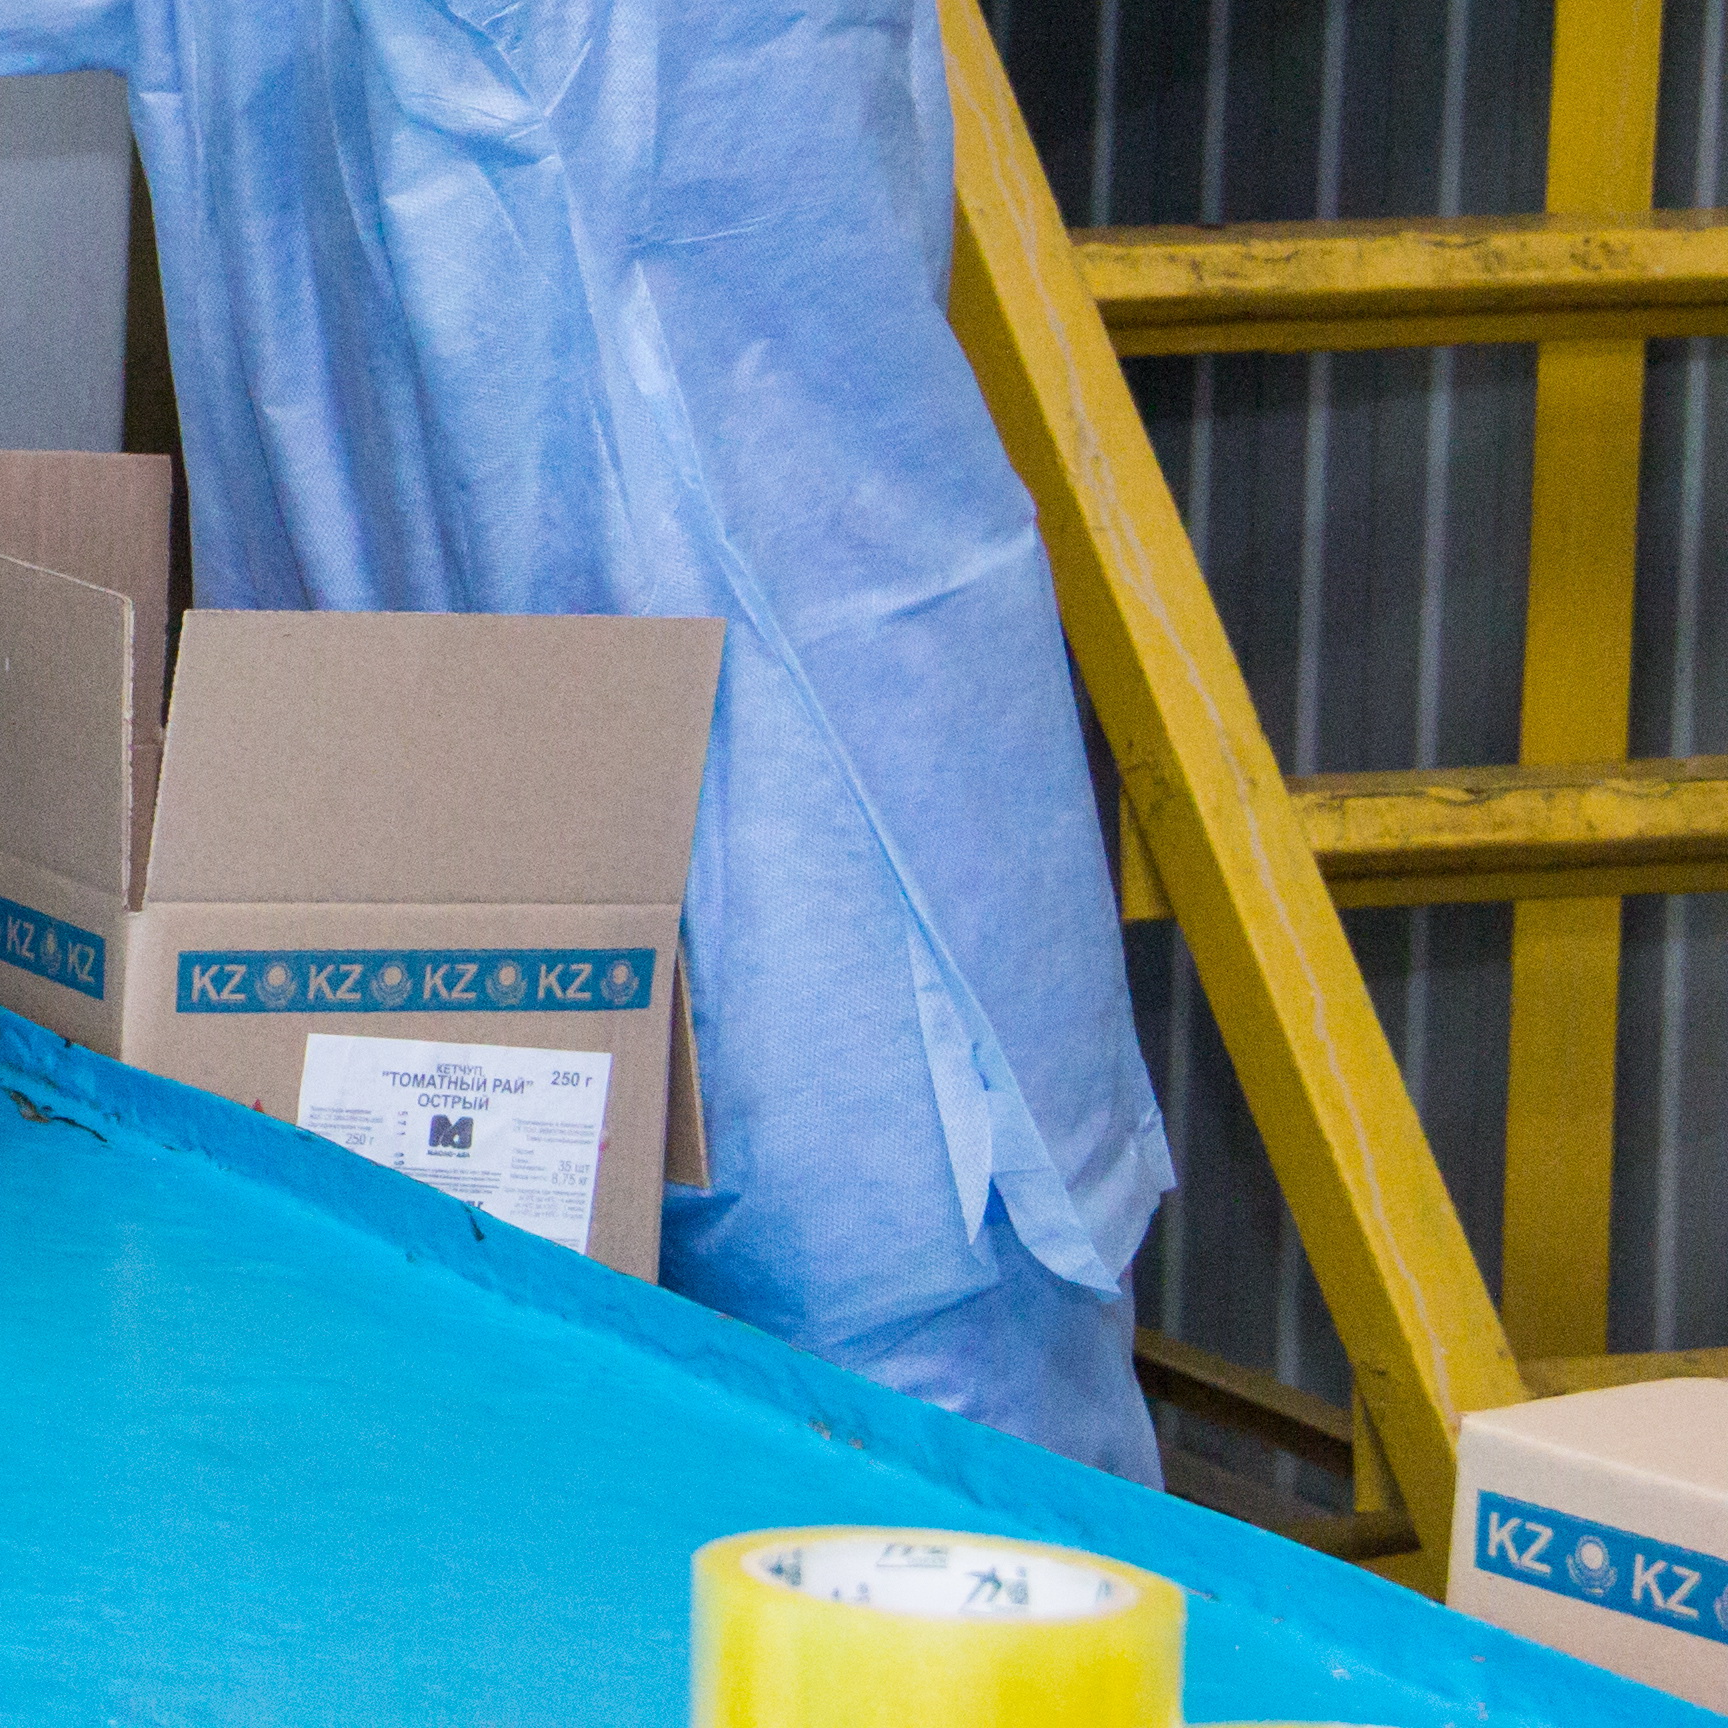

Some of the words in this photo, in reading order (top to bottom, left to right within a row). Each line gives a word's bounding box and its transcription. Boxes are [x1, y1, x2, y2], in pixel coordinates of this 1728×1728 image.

[6, 915, 36, 962] KZ
[66, 941, 96, 985] KZ
[191, 964, 247, 1003] KZ
[307, 963, 364, 1001] KZ
[423, 963, 479, 1001] KZ
[537, 963, 593, 1000] KZ
[550, 1070, 580, 1087] 250
[417, 1092, 490, 1111] ОСТРЫЙ
[558, 1160, 572, 1173] 35
[1487, 1511, 1554, 1577] KZ
[1631, 1553, 1703, 1620] KZ
